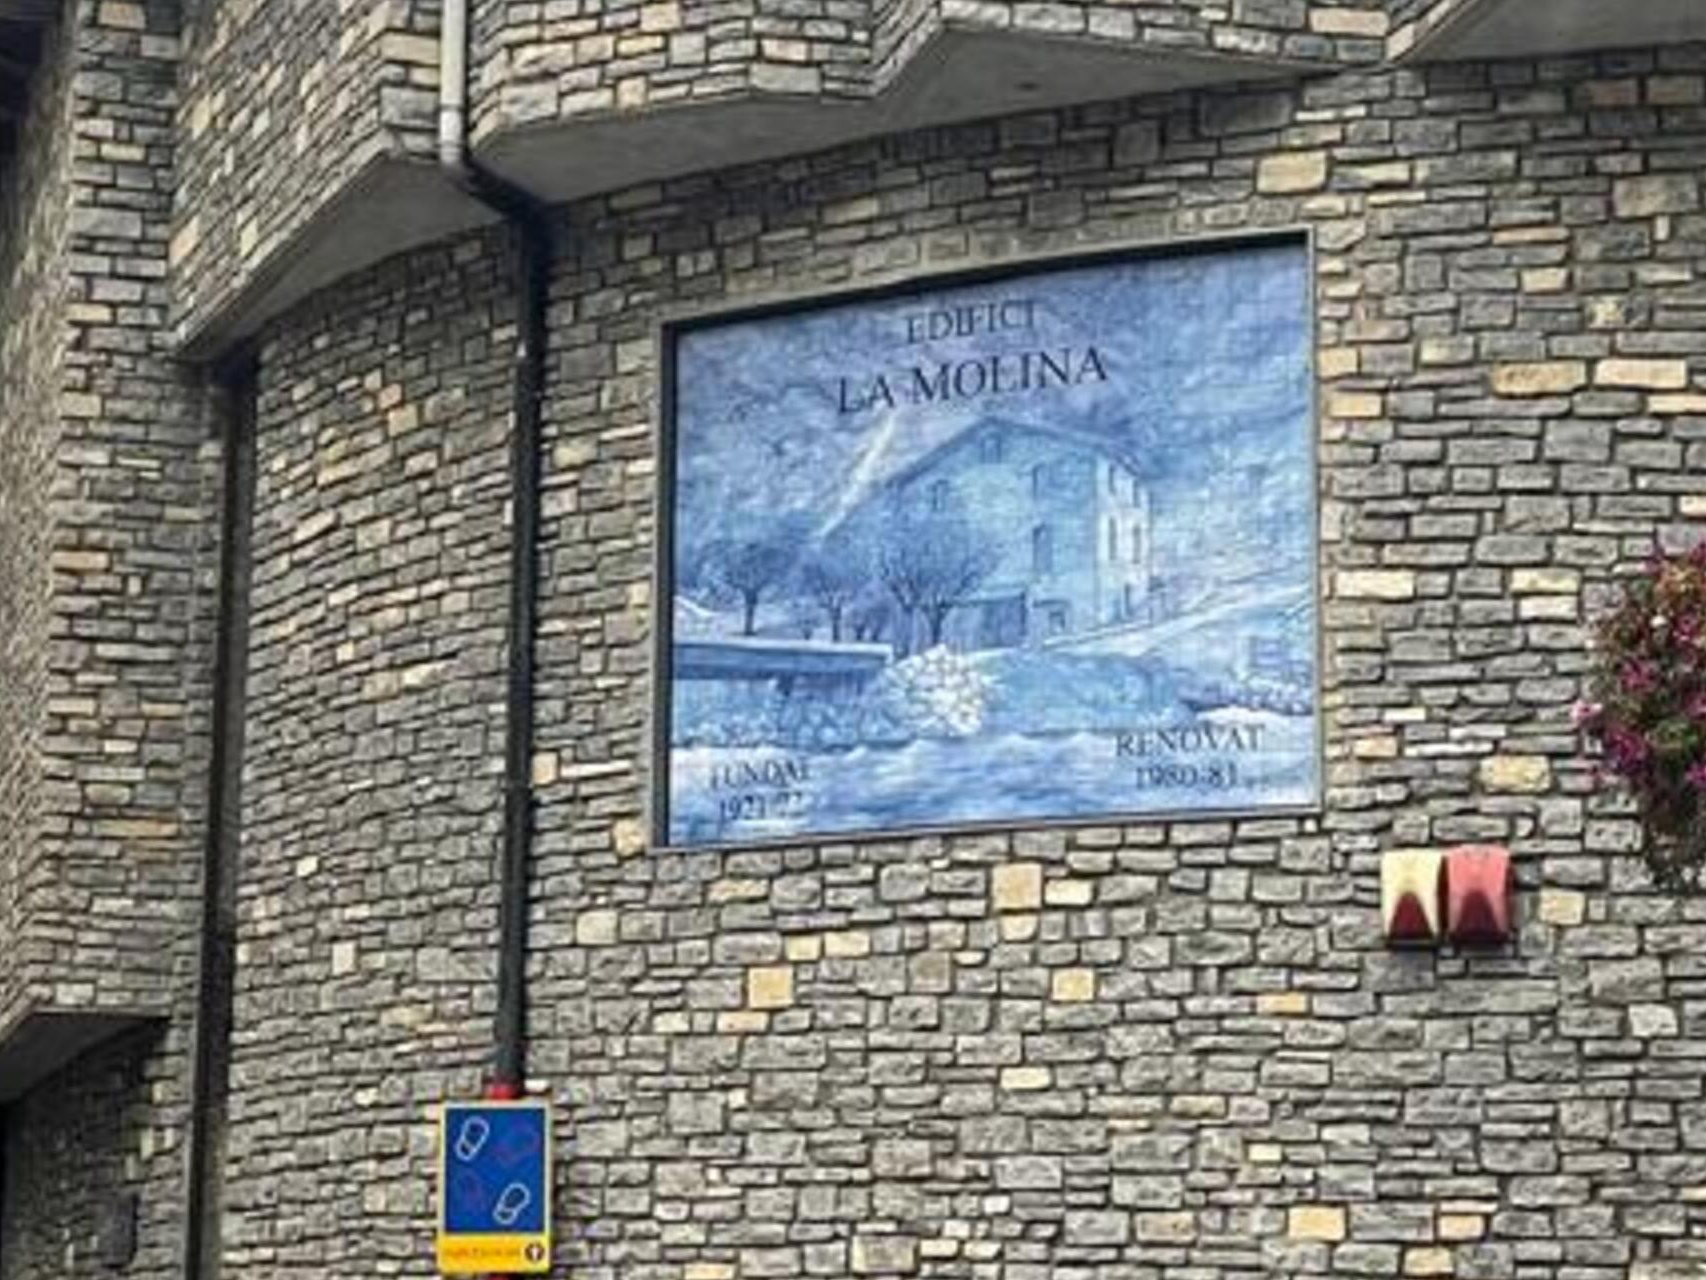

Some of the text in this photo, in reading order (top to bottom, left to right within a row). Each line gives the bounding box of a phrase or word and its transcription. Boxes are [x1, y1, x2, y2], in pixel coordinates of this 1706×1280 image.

[905, 299, 1035, 345] EDIFICI
[838, 345, 1108, 416] LA MOLINA
[1115, 720, 1267, 757] RENOVAT
